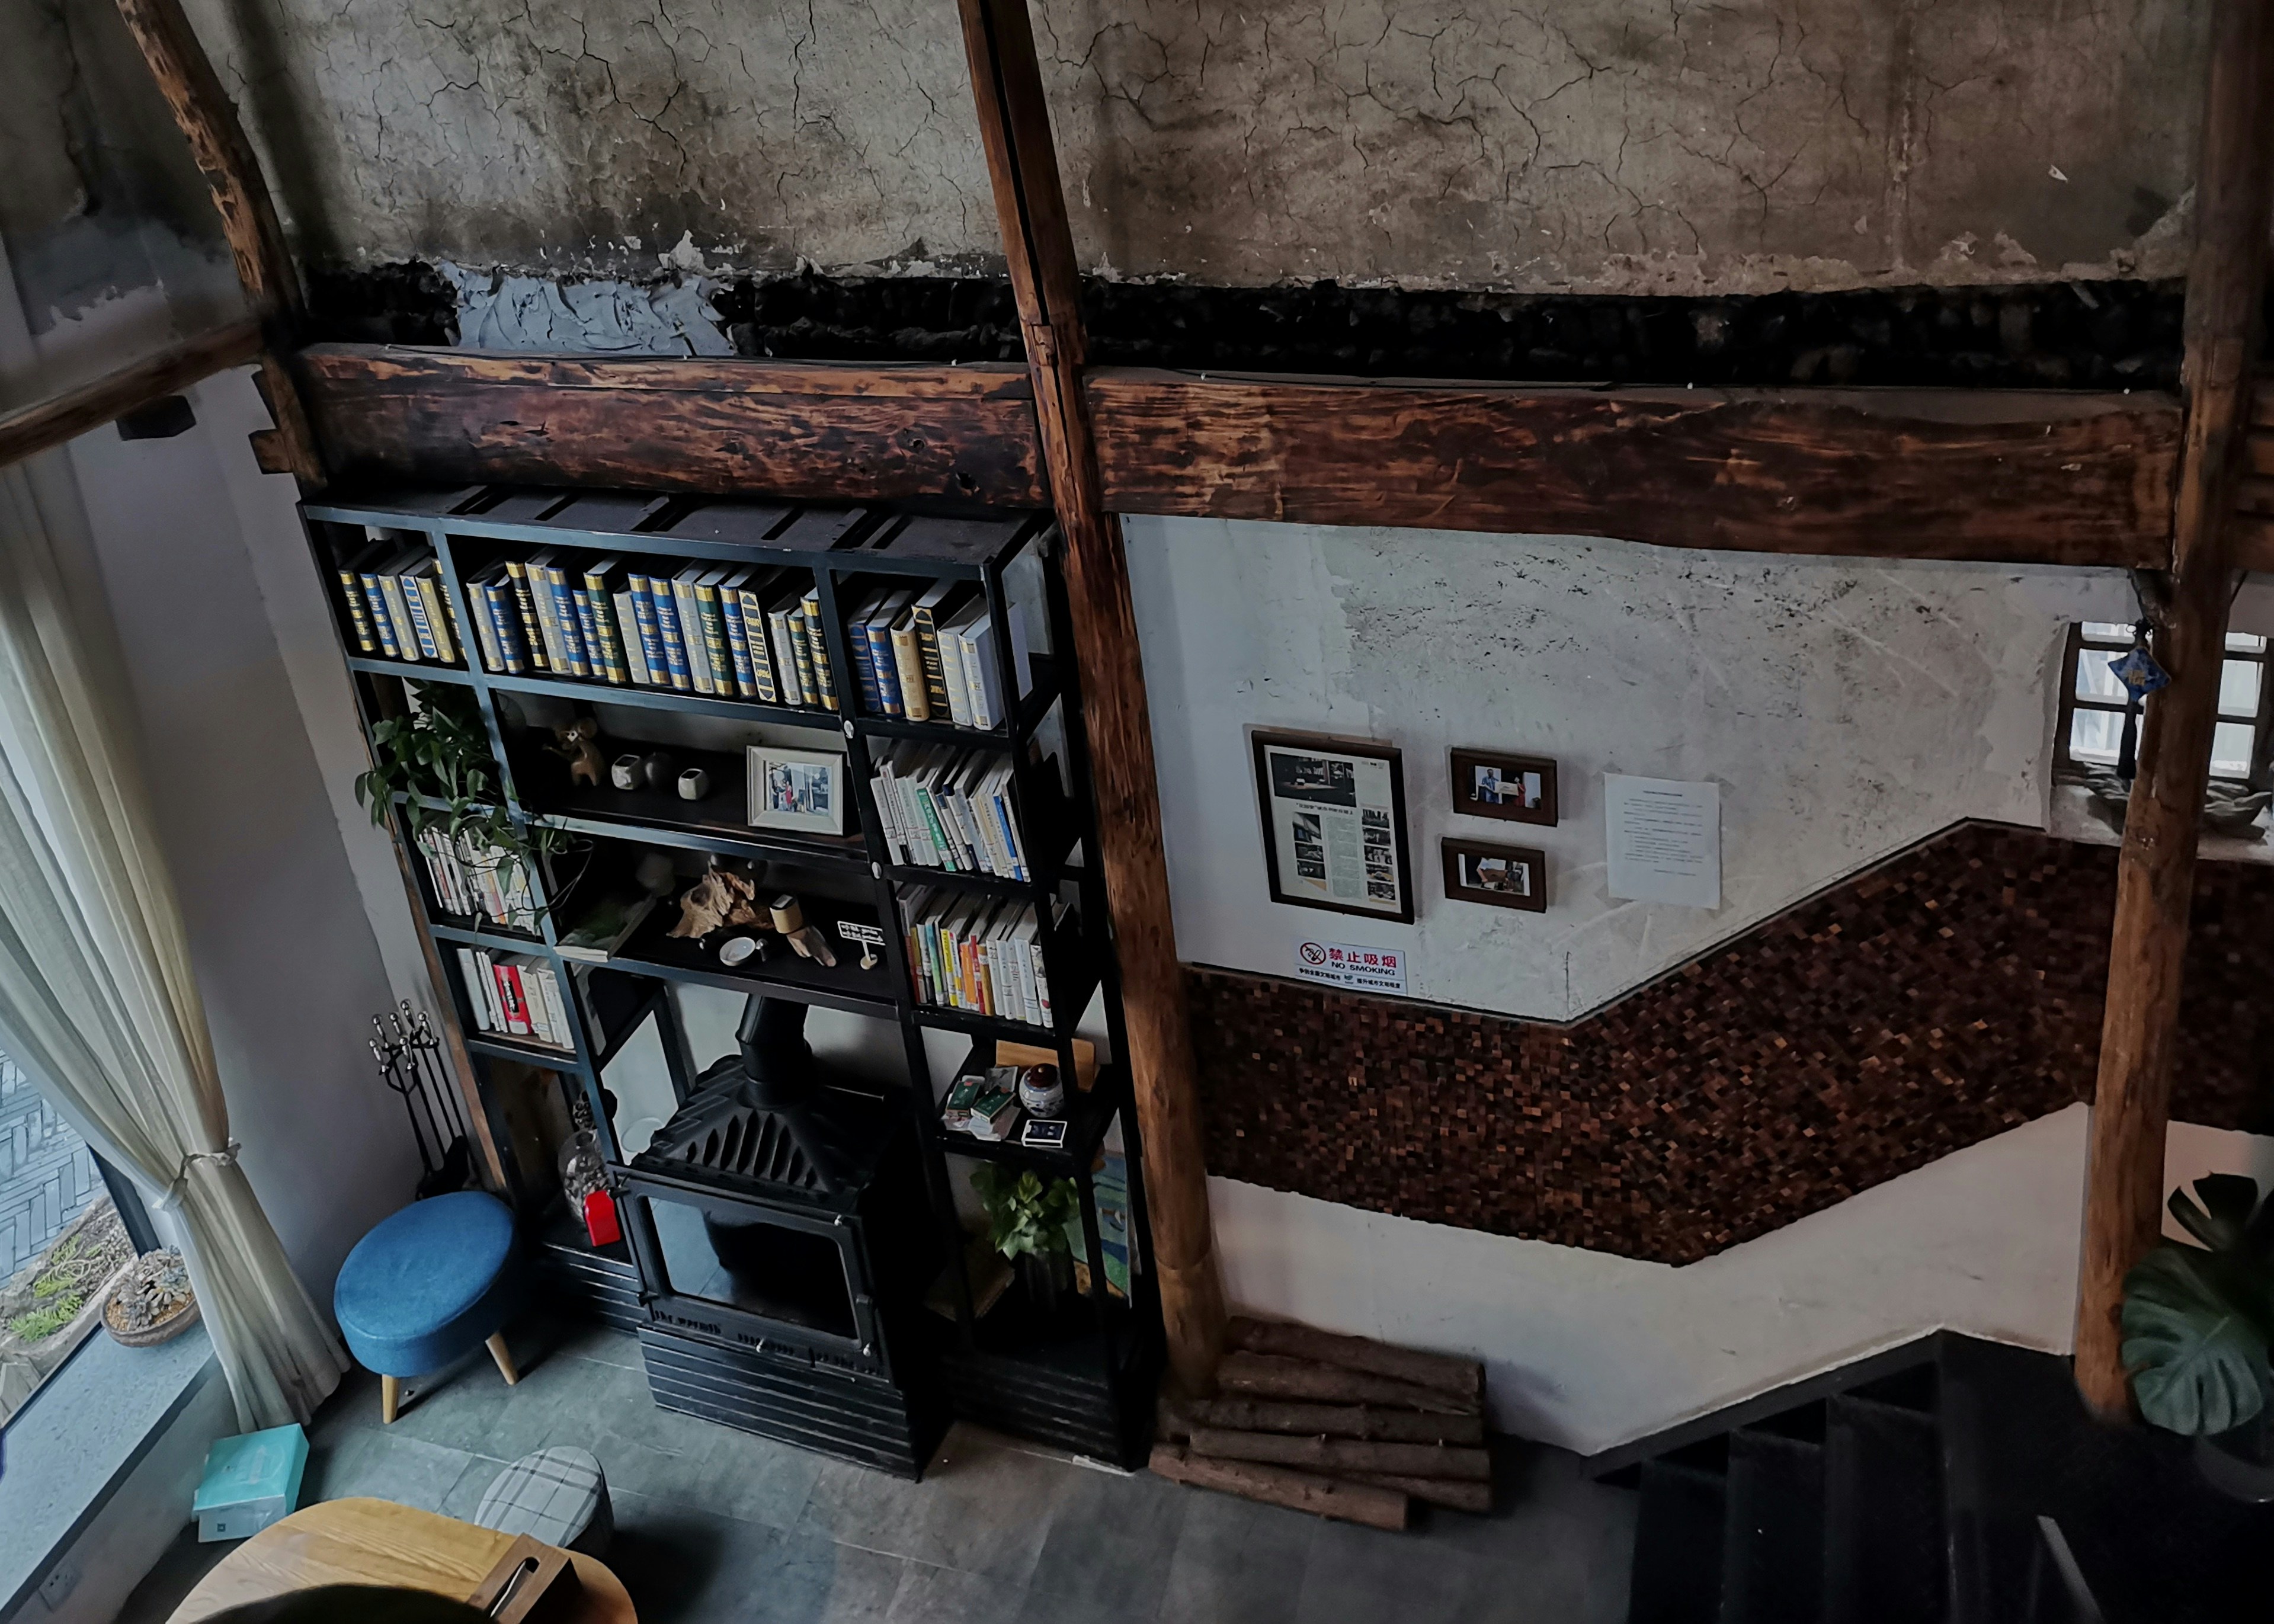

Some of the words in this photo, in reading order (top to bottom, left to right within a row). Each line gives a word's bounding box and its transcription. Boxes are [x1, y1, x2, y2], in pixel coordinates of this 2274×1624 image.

[1328, 947, 1397, 968] 禁止吸烟
[1331, 961, 1346, 969] NO
[1350, 964, 1395, 976] SMOKING
